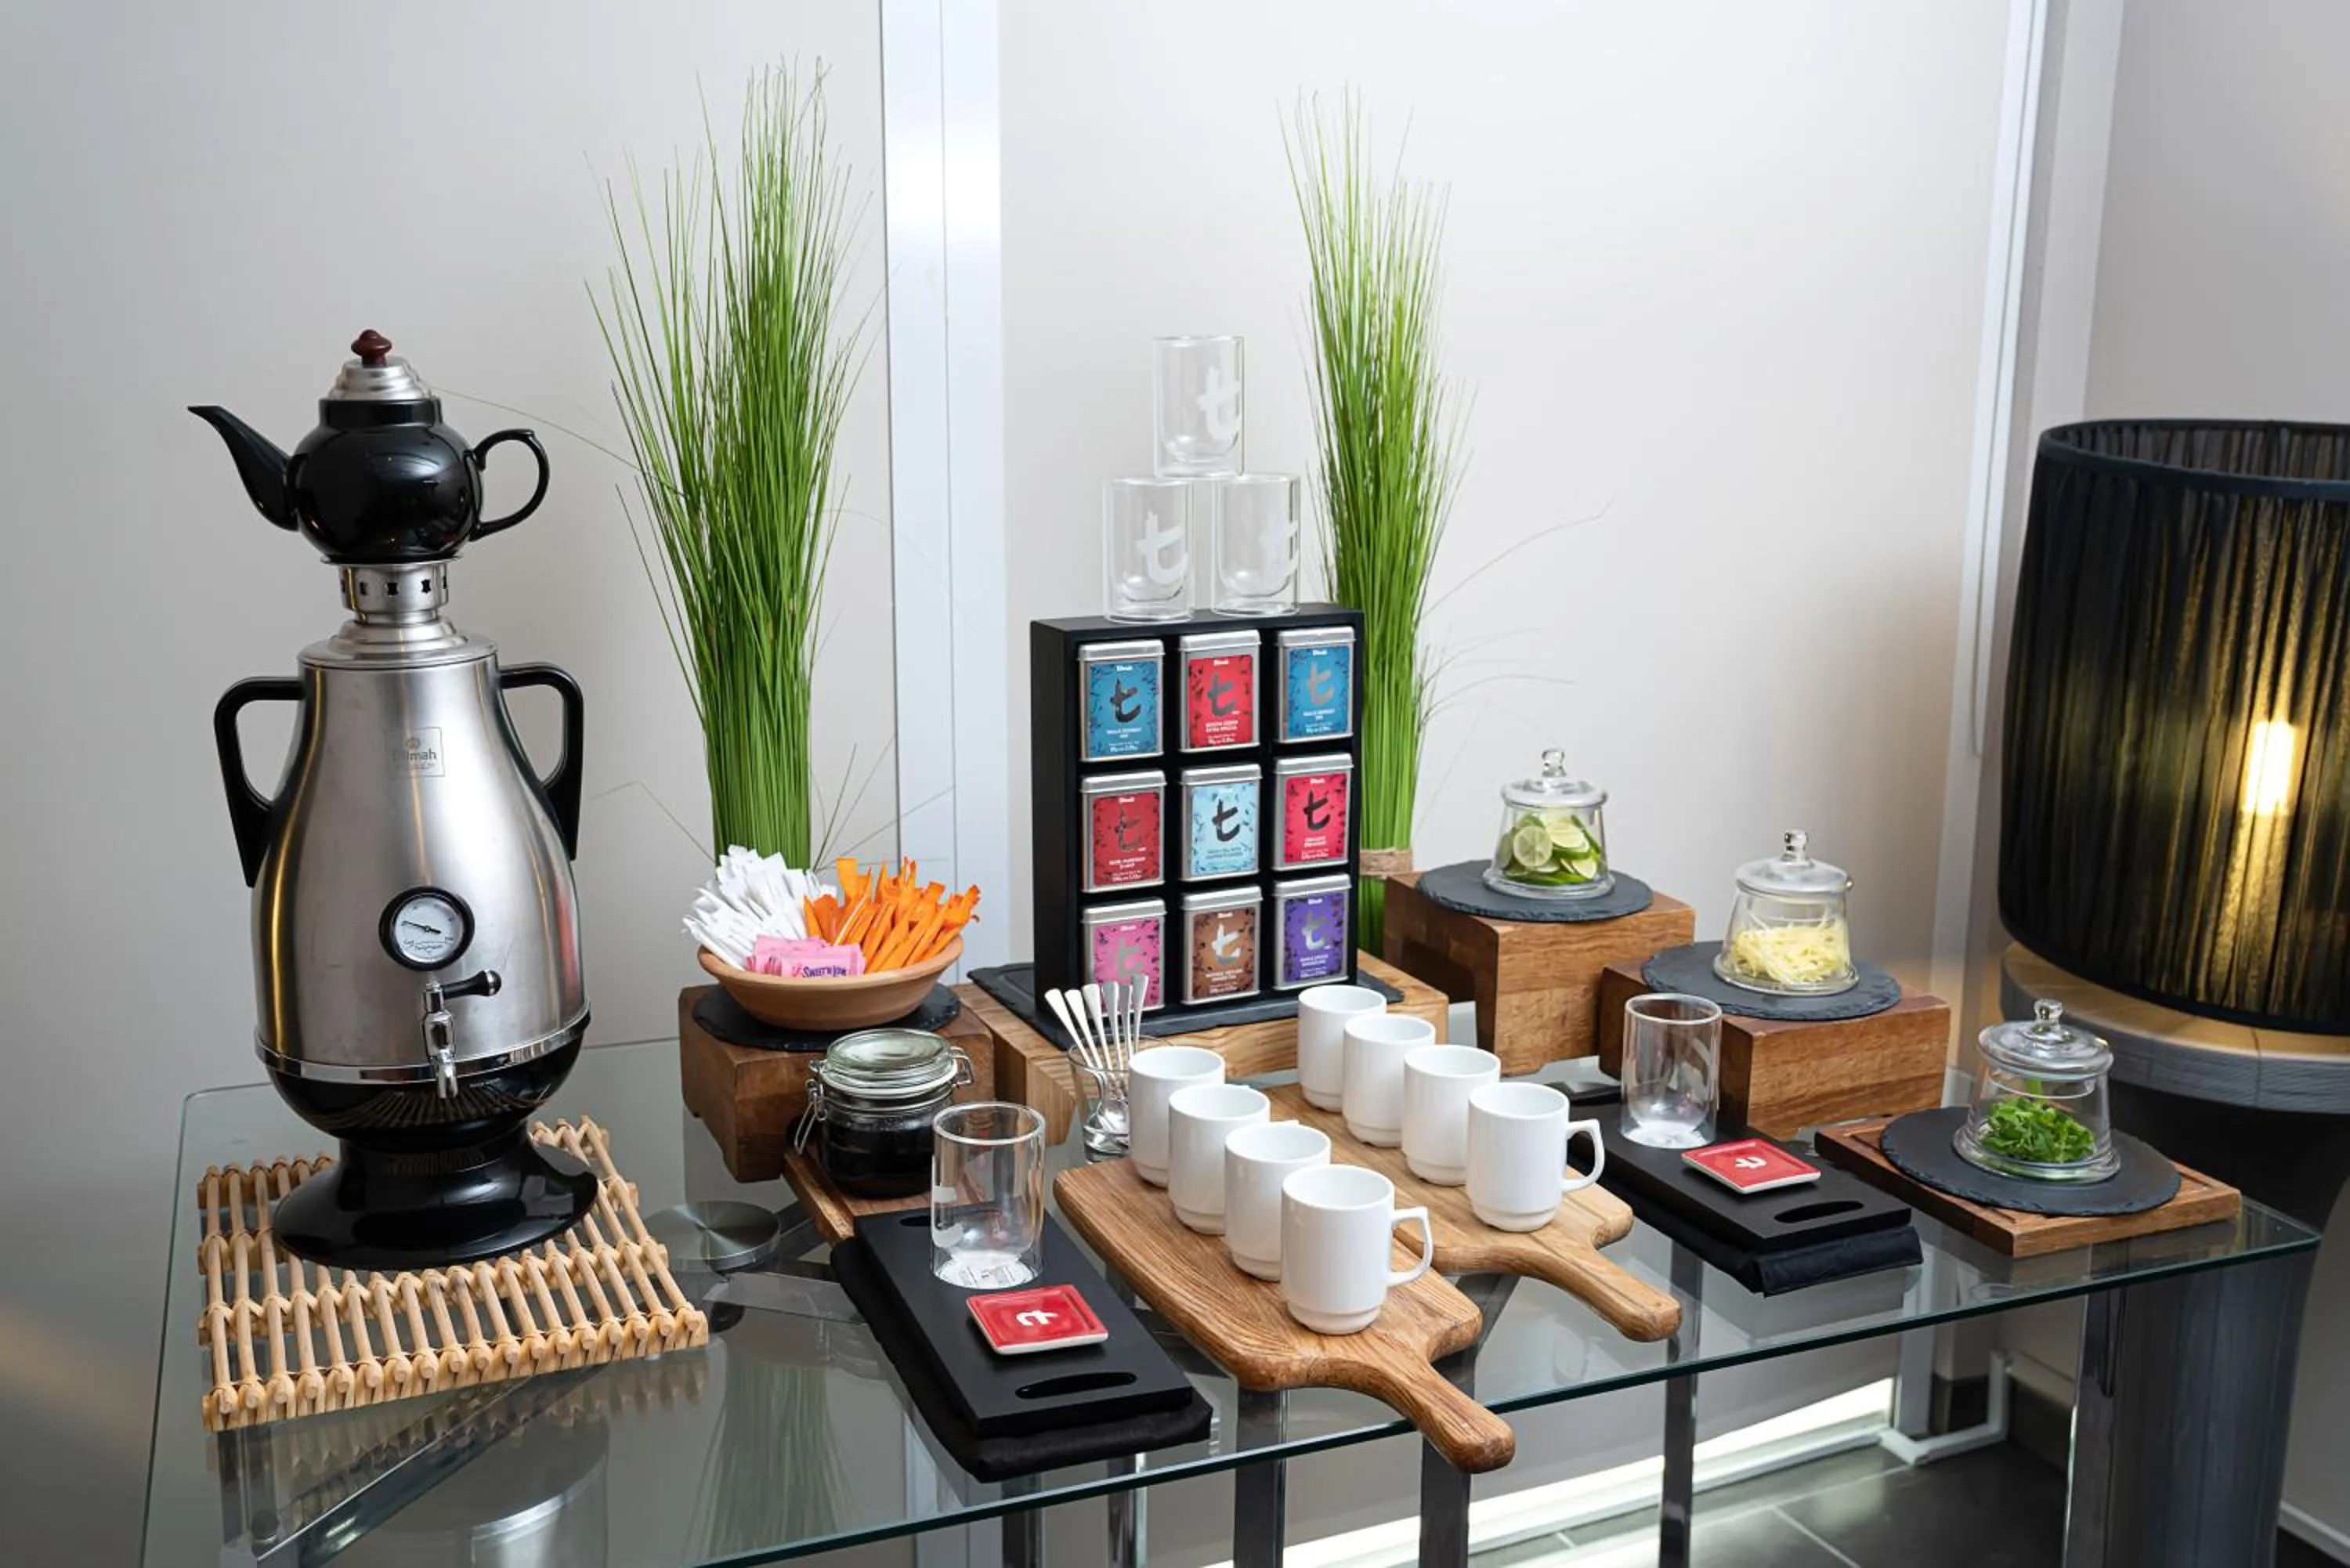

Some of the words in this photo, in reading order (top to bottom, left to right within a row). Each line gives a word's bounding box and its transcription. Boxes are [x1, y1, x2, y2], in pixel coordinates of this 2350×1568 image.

[1137, 511, 1189, 585] t
[1109, 677, 1141, 723] t
[1207, 674, 1235, 717] t
[1307, 661, 1335, 706] t
[1115, 805, 1142, 852] t
[1211, 799, 1240, 842] t
[1303, 789, 1330, 831] t
[1211, 923, 1242, 966] t
